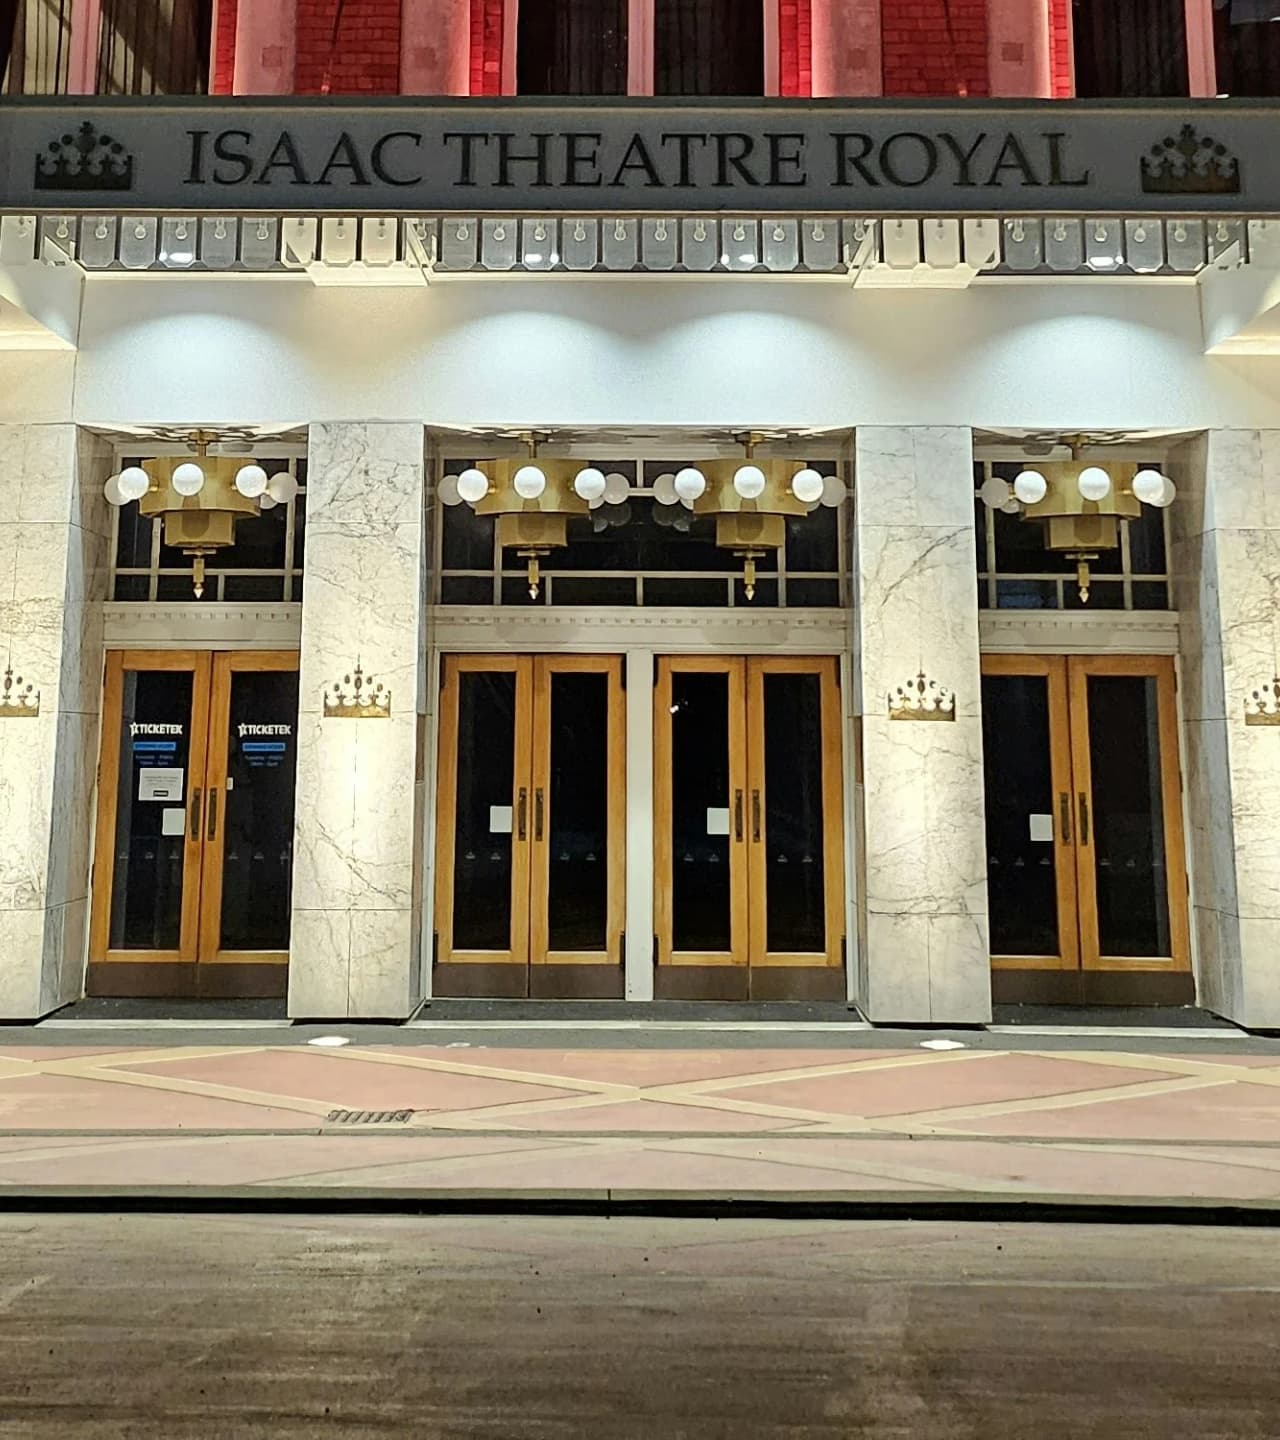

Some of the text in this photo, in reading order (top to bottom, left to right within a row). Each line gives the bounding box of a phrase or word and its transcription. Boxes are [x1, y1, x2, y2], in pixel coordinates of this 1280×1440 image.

[183, 130, 1089, 187] ISAAC THEATRE ROYAL
[137, 723, 183, 735] TICKETEK
[245, 724, 292, 736] TICKETEK
